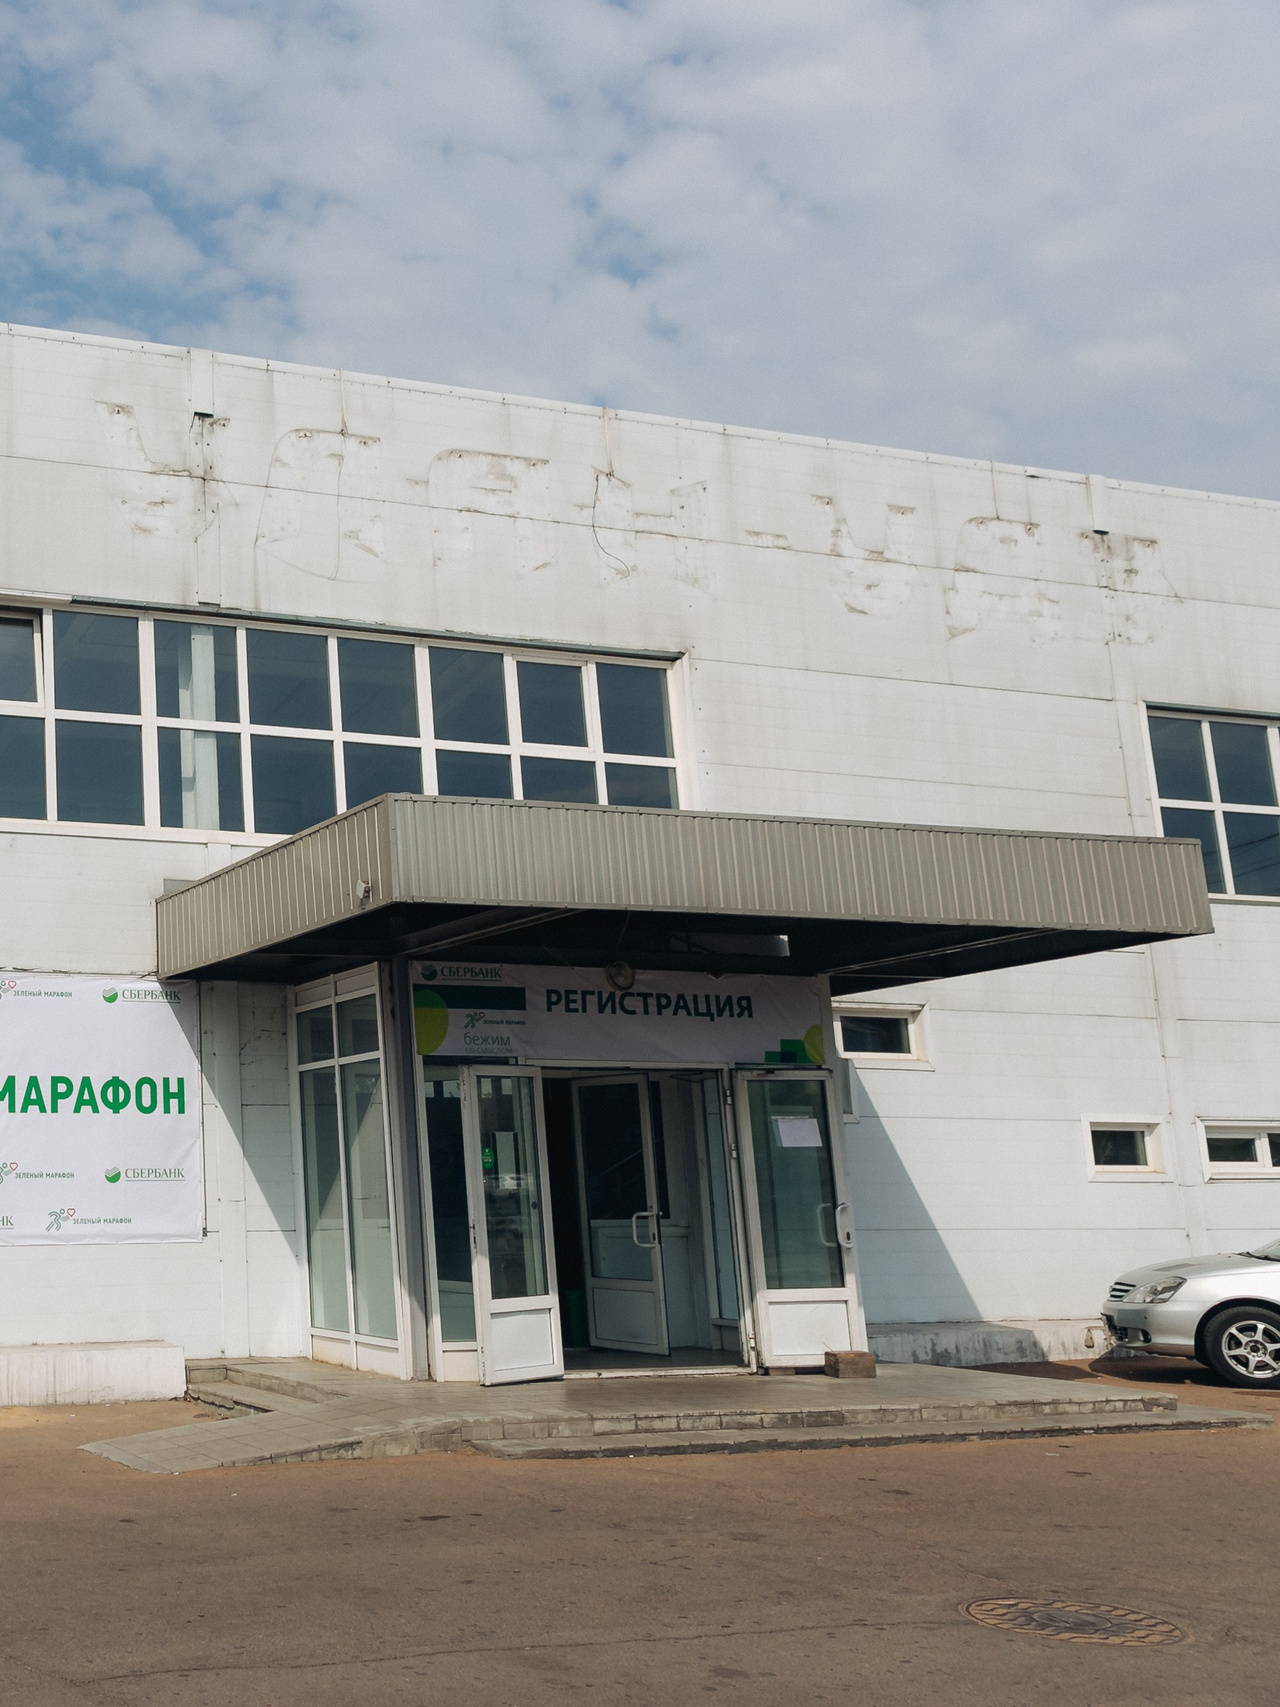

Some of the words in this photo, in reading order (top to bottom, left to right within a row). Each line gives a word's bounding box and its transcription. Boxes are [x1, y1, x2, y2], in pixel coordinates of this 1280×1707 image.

[440, 965, 503, 979] СБЕРБАНК
[13, 989, 43, 998] ЗЕЛЕНЫЙ
[43, 990, 73, 999] МАРАФОН
[121, 988, 181, 1001] СБЕРБАНК
[545, 988, 754, 1021] РЕГИСТРАЦИЯ
[464, 1031, 510, 1046] бежим
[14, 1171, 44, 1180] ЗЕЛЕНЫЙ
[45, 1171, 75, 1180] МАРАФОН
[124, 1167, 186, 1180] СБЕРБАНК
[72, 1216, 102, 1226] ЗЕЛЕНЫЙ
[102, 1216, 132, 1225] МАРАФОН
